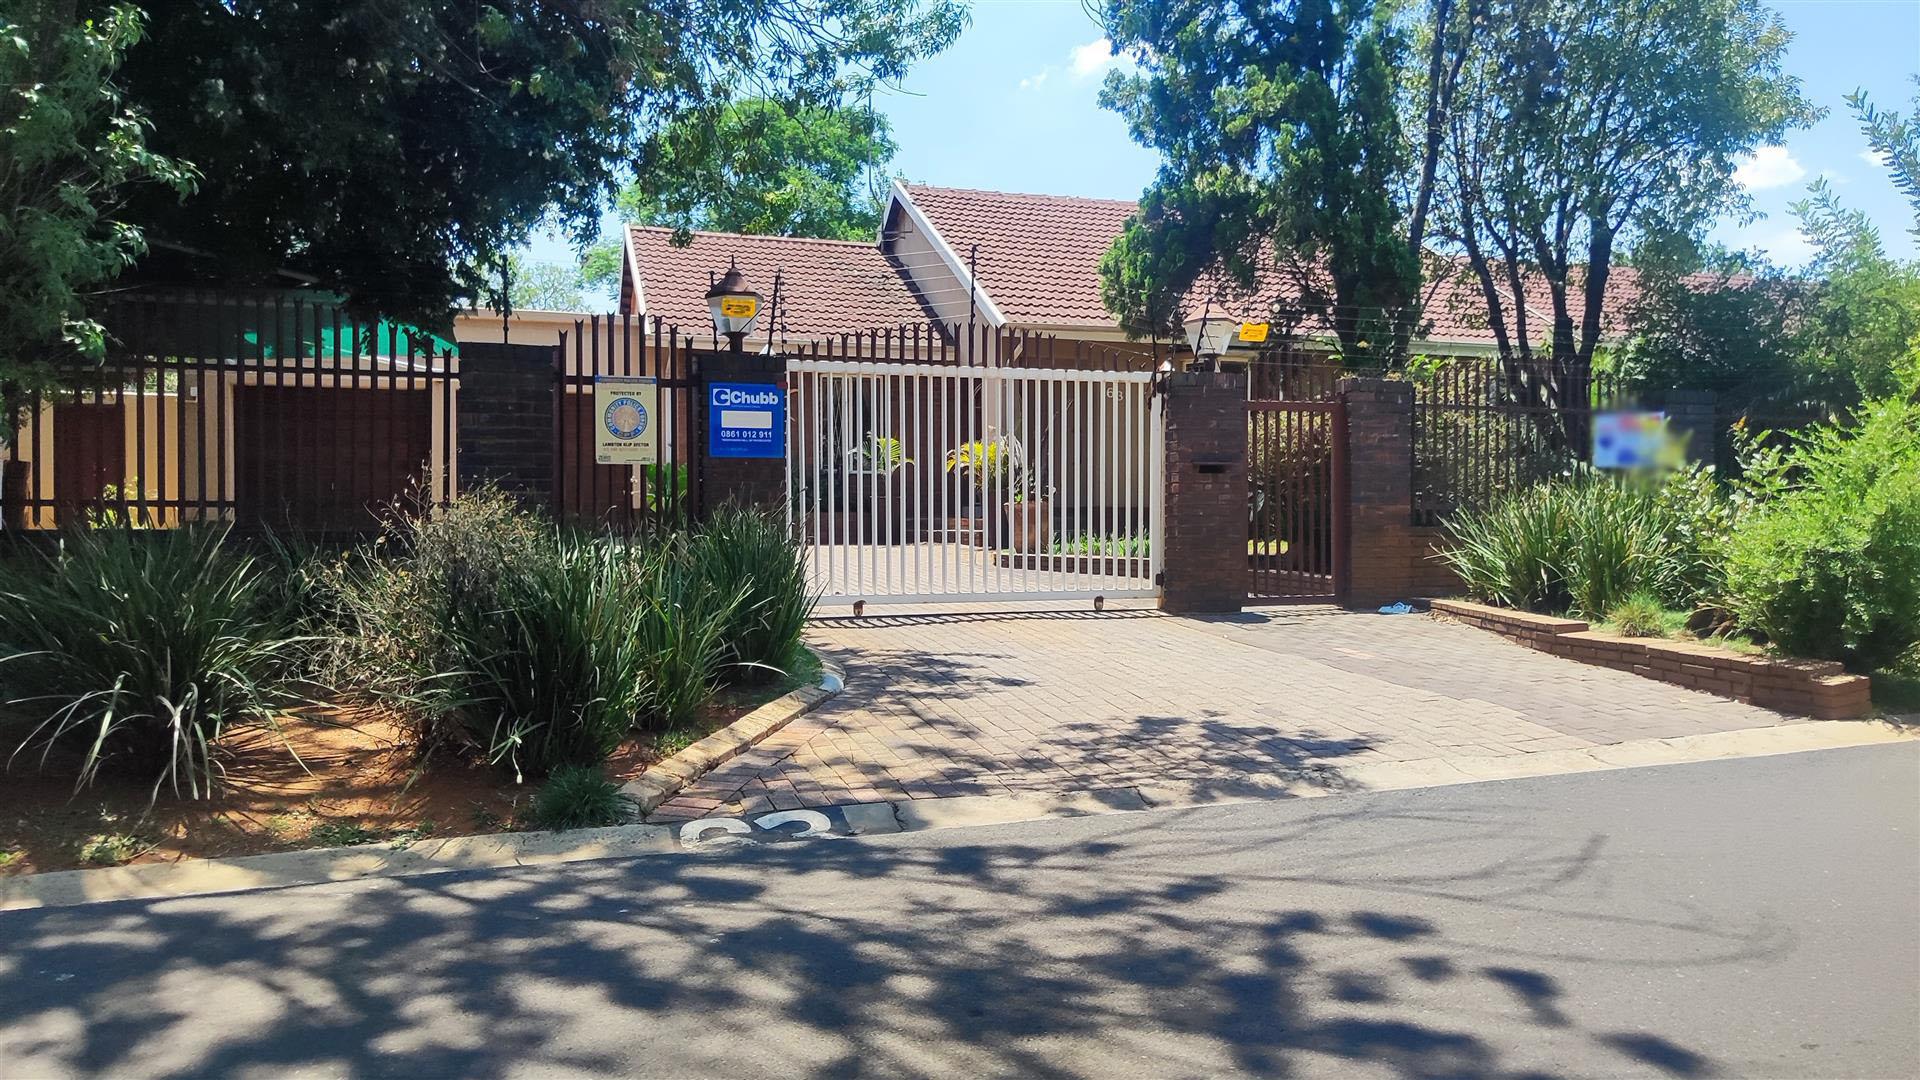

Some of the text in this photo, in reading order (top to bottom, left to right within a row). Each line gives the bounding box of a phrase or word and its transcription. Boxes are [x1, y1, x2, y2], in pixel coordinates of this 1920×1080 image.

[730, 390, 779, 405] Chubb
[721, 430, 772, 439] 0861 012 911
